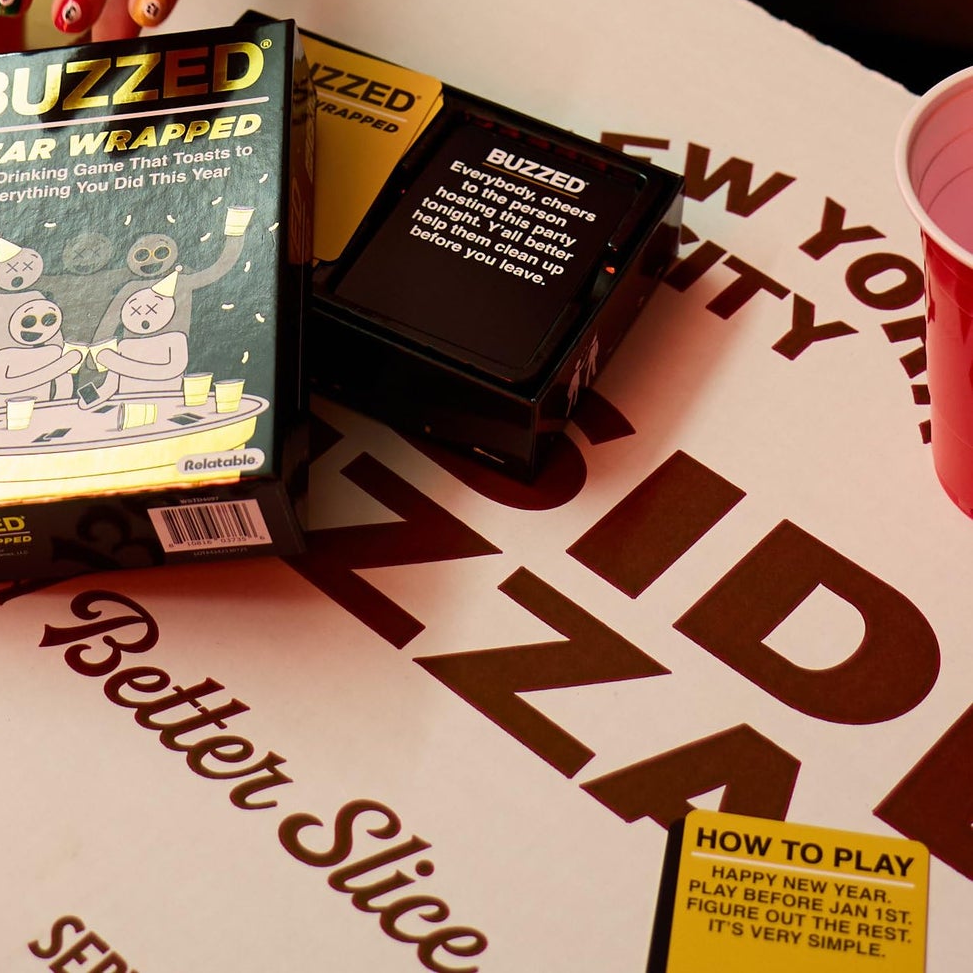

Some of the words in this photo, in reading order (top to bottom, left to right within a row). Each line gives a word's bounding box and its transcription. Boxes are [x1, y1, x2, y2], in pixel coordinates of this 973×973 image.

[69, 113, 262, 157] WRAPPED
[73, 161, 124, 176] Game
[130, 155, 169, 170] That
[174, 148, 230, 166] Toasts
[235, 145, 253, 157] to
[76, 179, 108, 195] You
[115, 175, 143, 190] Did
[149, 170, 186, 186] This
[193, 165, 231, 181] Year
[449, 160, 536, 202] Everybody,
[541, 196, 596, 223] cheers
[461, 181, 478, 194] to
[481, 186, 508, 205] the
[508, 198, 567, 228] person
[421, 196, 482, 228] tonight.
[487, 220, 522, 242] Y'all
[523, 233, 574, 262] better
[435, 186, 496, 219] hosting
[499, 208, 530, 229] this
[531, 222, 577, 248] party
[409, 225, 462, 253] before
[463, 245, 497, 269] you
[498, 255, 547, 286] leave.
[411, 209, 448, 234] help
[450, 222, 492, 248] them
[494, 239, 538, 267] clean
[542, 258, 565, 277] up
[662, 224, 859, 361] ITY
[38, 589, 293, 810] Better
[278, 799, 488, 973] Slice
[696, 826, 772, 857] HOW
[781, 839, 823, 864] TO
[833, 847, 914, 877] PLAY
[688, 879, 737, 900] PLAY
[743, 888, 823, 911] BEFORE
[829, 901, 868, 919] JAN
[874, 908, 913, 925] 1ST.
[711, 865, 778, 886] HAPPY
[783, 876, 829, 895] NEW
[833, 883, 891, 904] YEAR.
[686, 897, 759, 920] FIGURE
[765, 908, 808, 927] OUT
[812, 915, 852, 934] THE
[857, 921, 912, 944] REST.
[707, 918, 745, 937] IT'S
[751, 925, 802, 946] VERY
[807, 933, 886, 958] SIMPLE.
